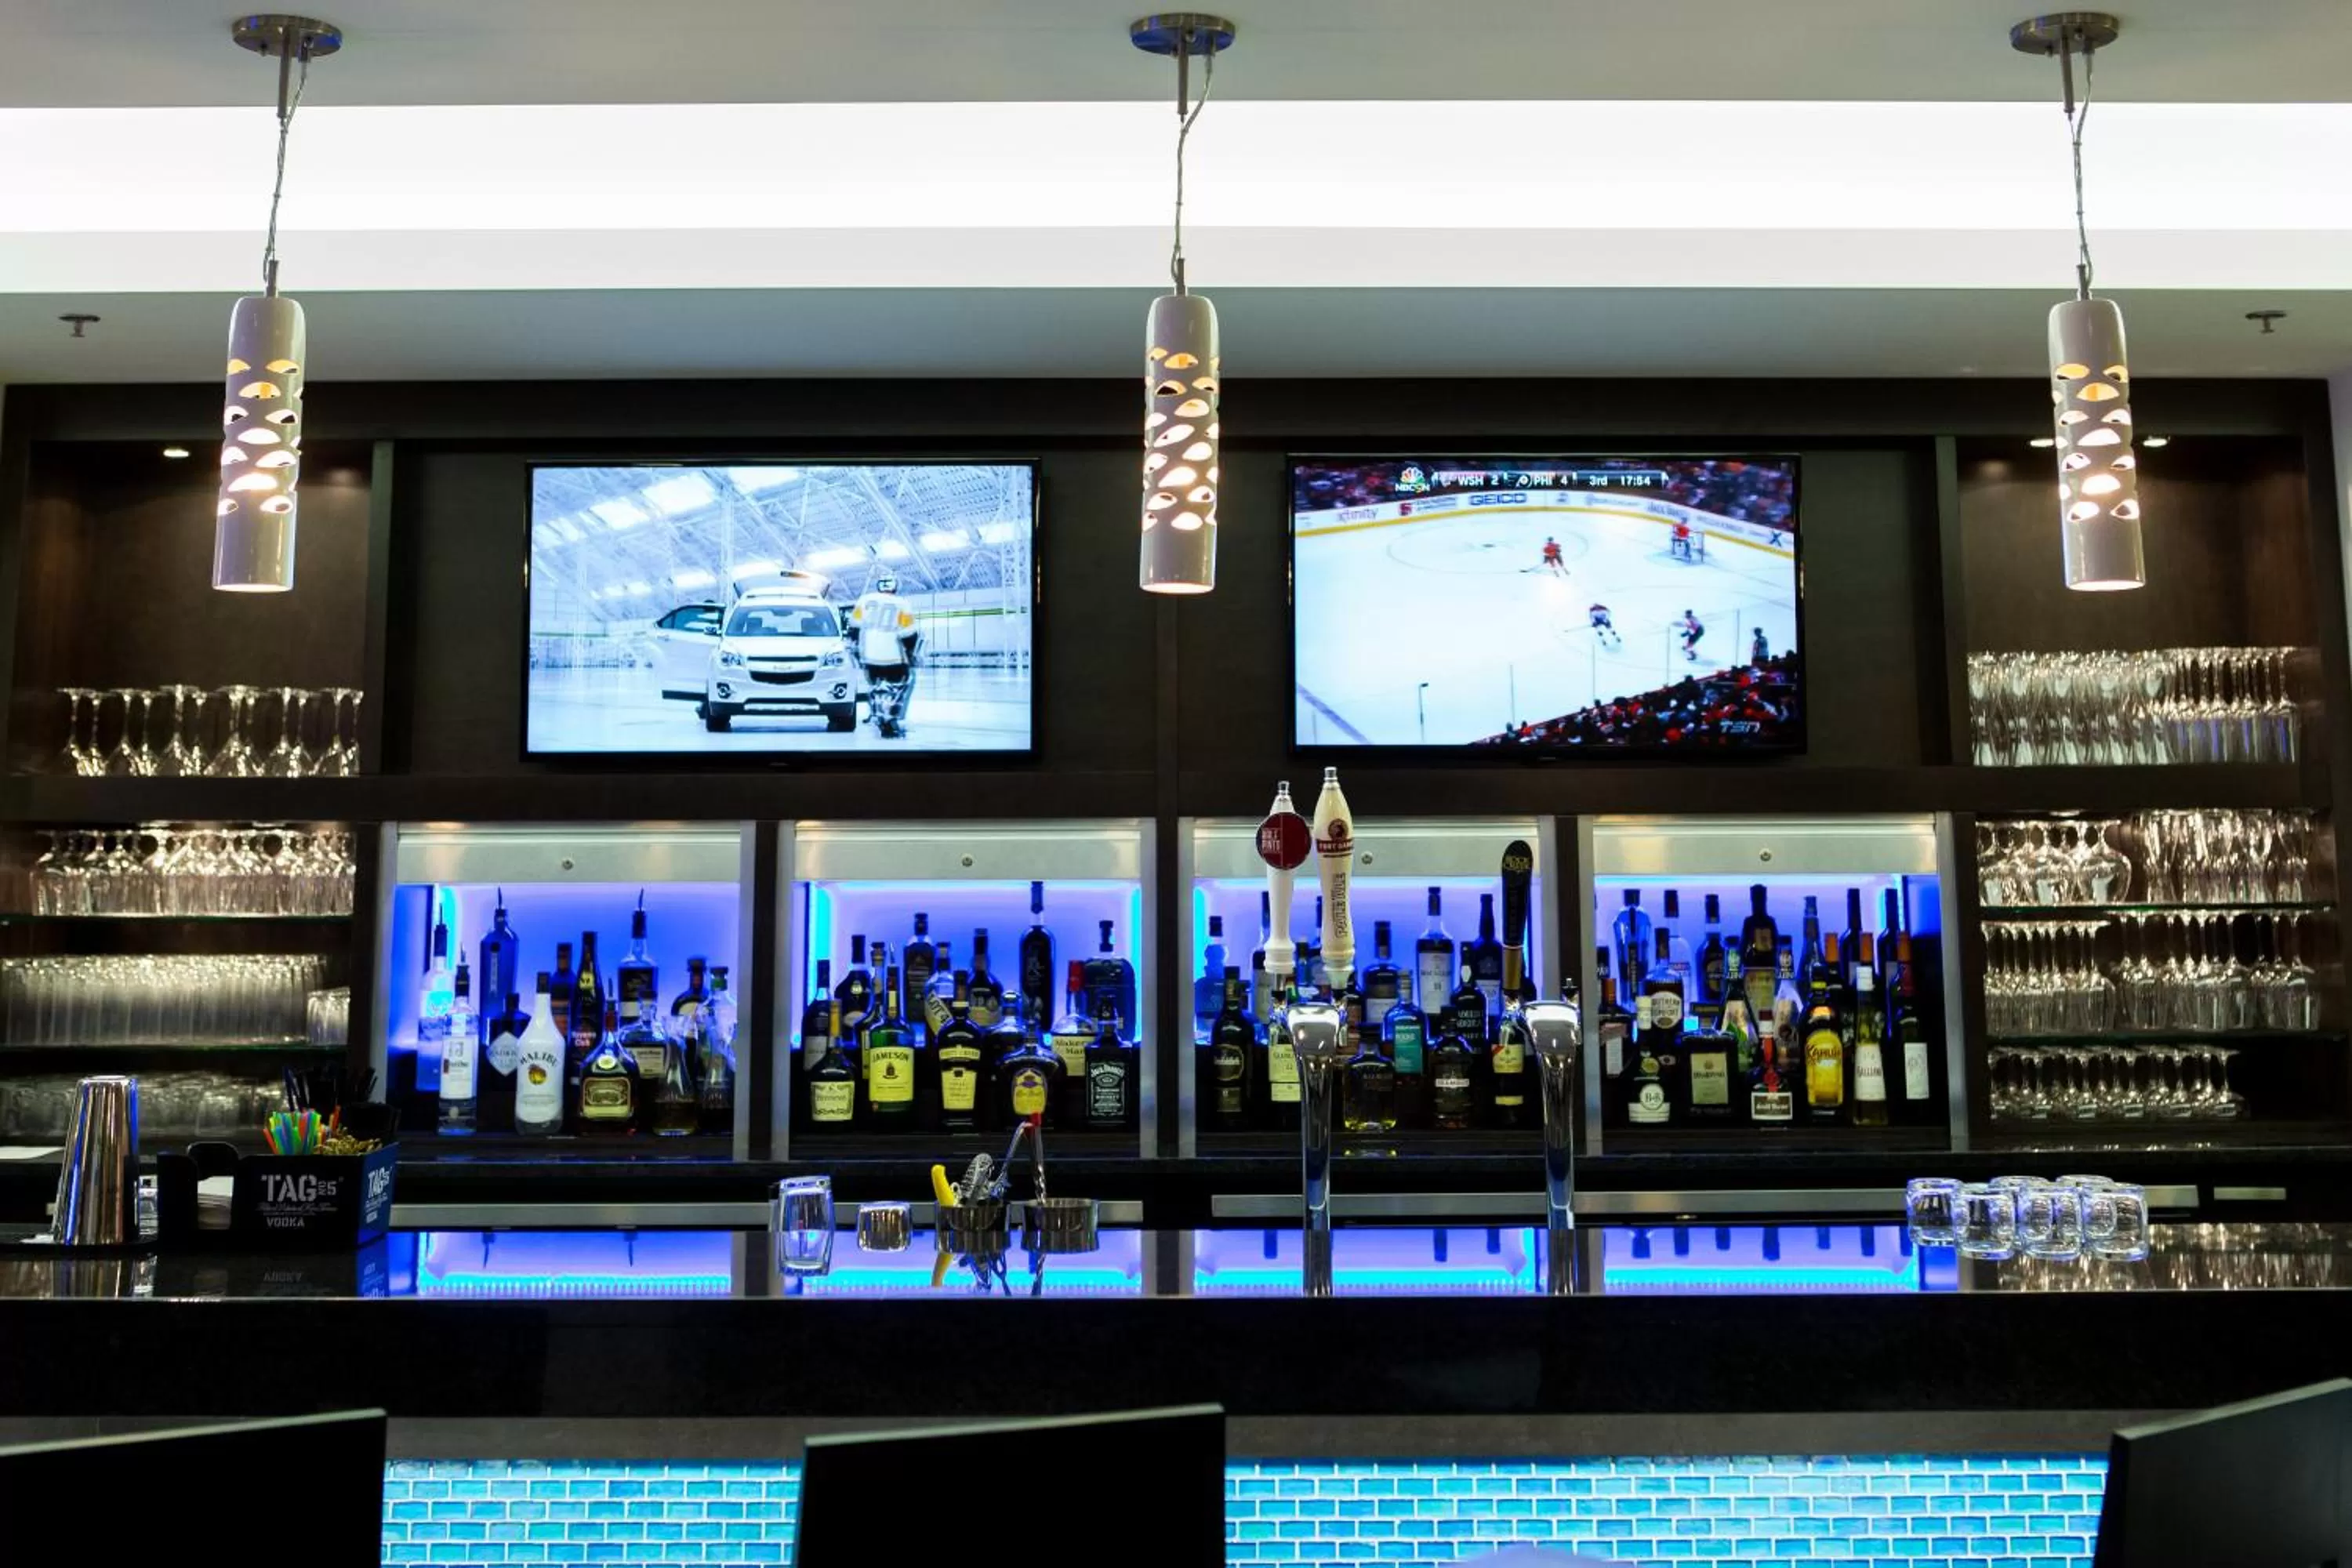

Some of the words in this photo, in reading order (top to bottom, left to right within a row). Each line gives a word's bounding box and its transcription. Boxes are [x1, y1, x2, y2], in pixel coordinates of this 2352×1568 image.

[1458, 474, 1484, 486] WSH
[1490, 474, 1500, 486] 2
[1534, 474, 1553, 486] PHI
[1559, 474, 1569, 485] 4
[1589, 474, 1608, 486] 3rd
[1468, 493, 1528, 506] GEICO
[1720, 720, 1761, 733] TSN
[873, 1051, 909, 1062] JAMESON
[1065, 1047, 1085, 1055] Mar
[520, 1051, 557, 1066] MALIBU
[261, 1174, 318, 1203] TAG
[367, 1167, 385, 1199] TAG
[266, 1216, 305, 1228] VODKA
